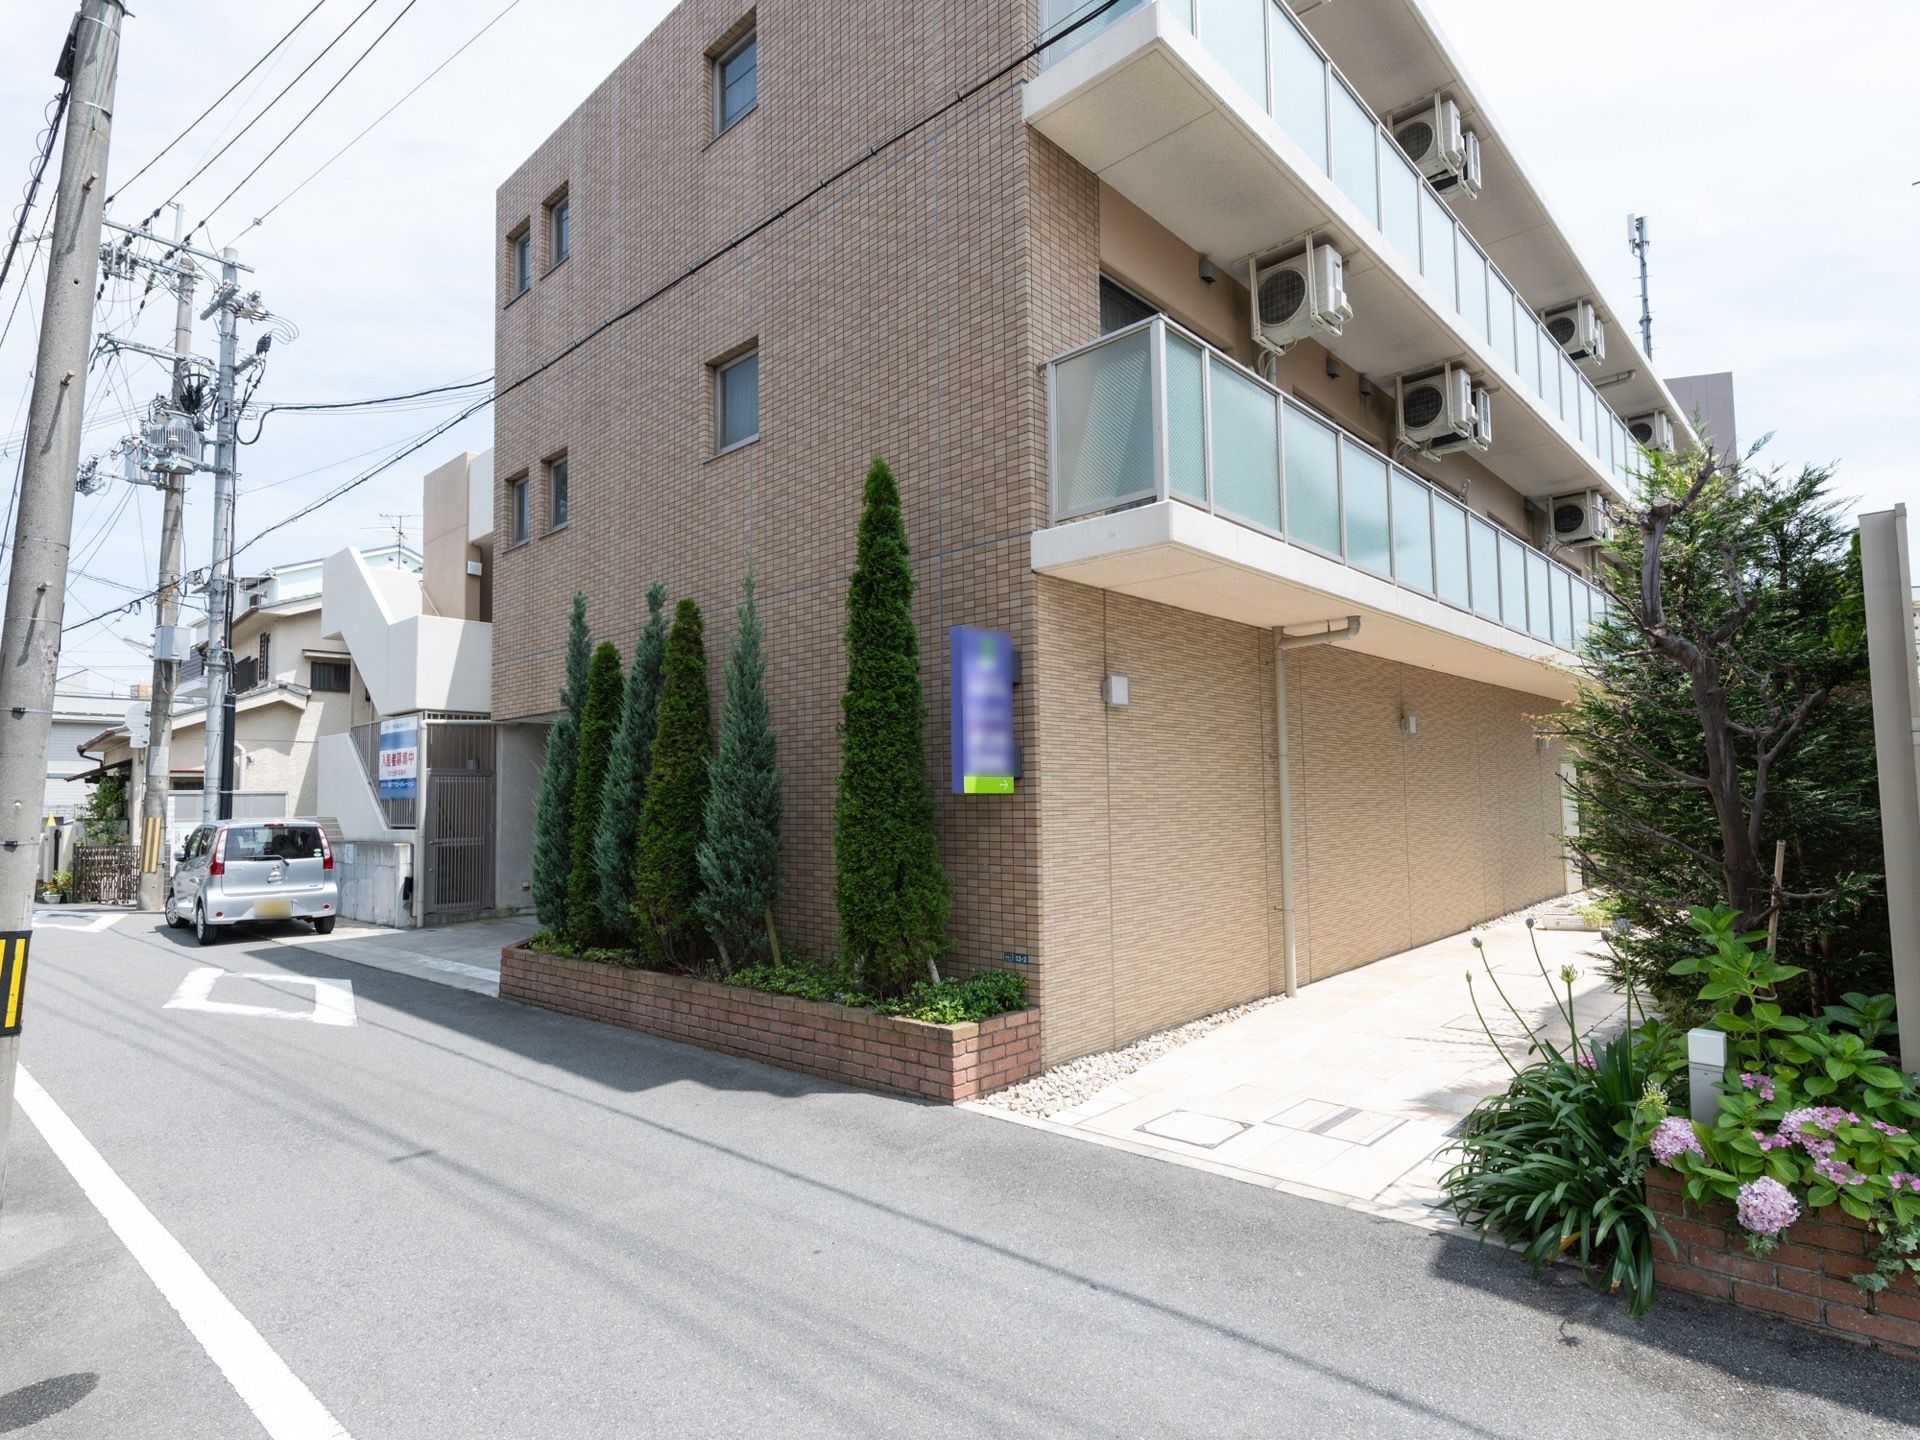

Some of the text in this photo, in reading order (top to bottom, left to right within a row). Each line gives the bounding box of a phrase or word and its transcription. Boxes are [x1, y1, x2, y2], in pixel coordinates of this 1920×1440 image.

[381, 751, 415, 767] 入居者募集中
